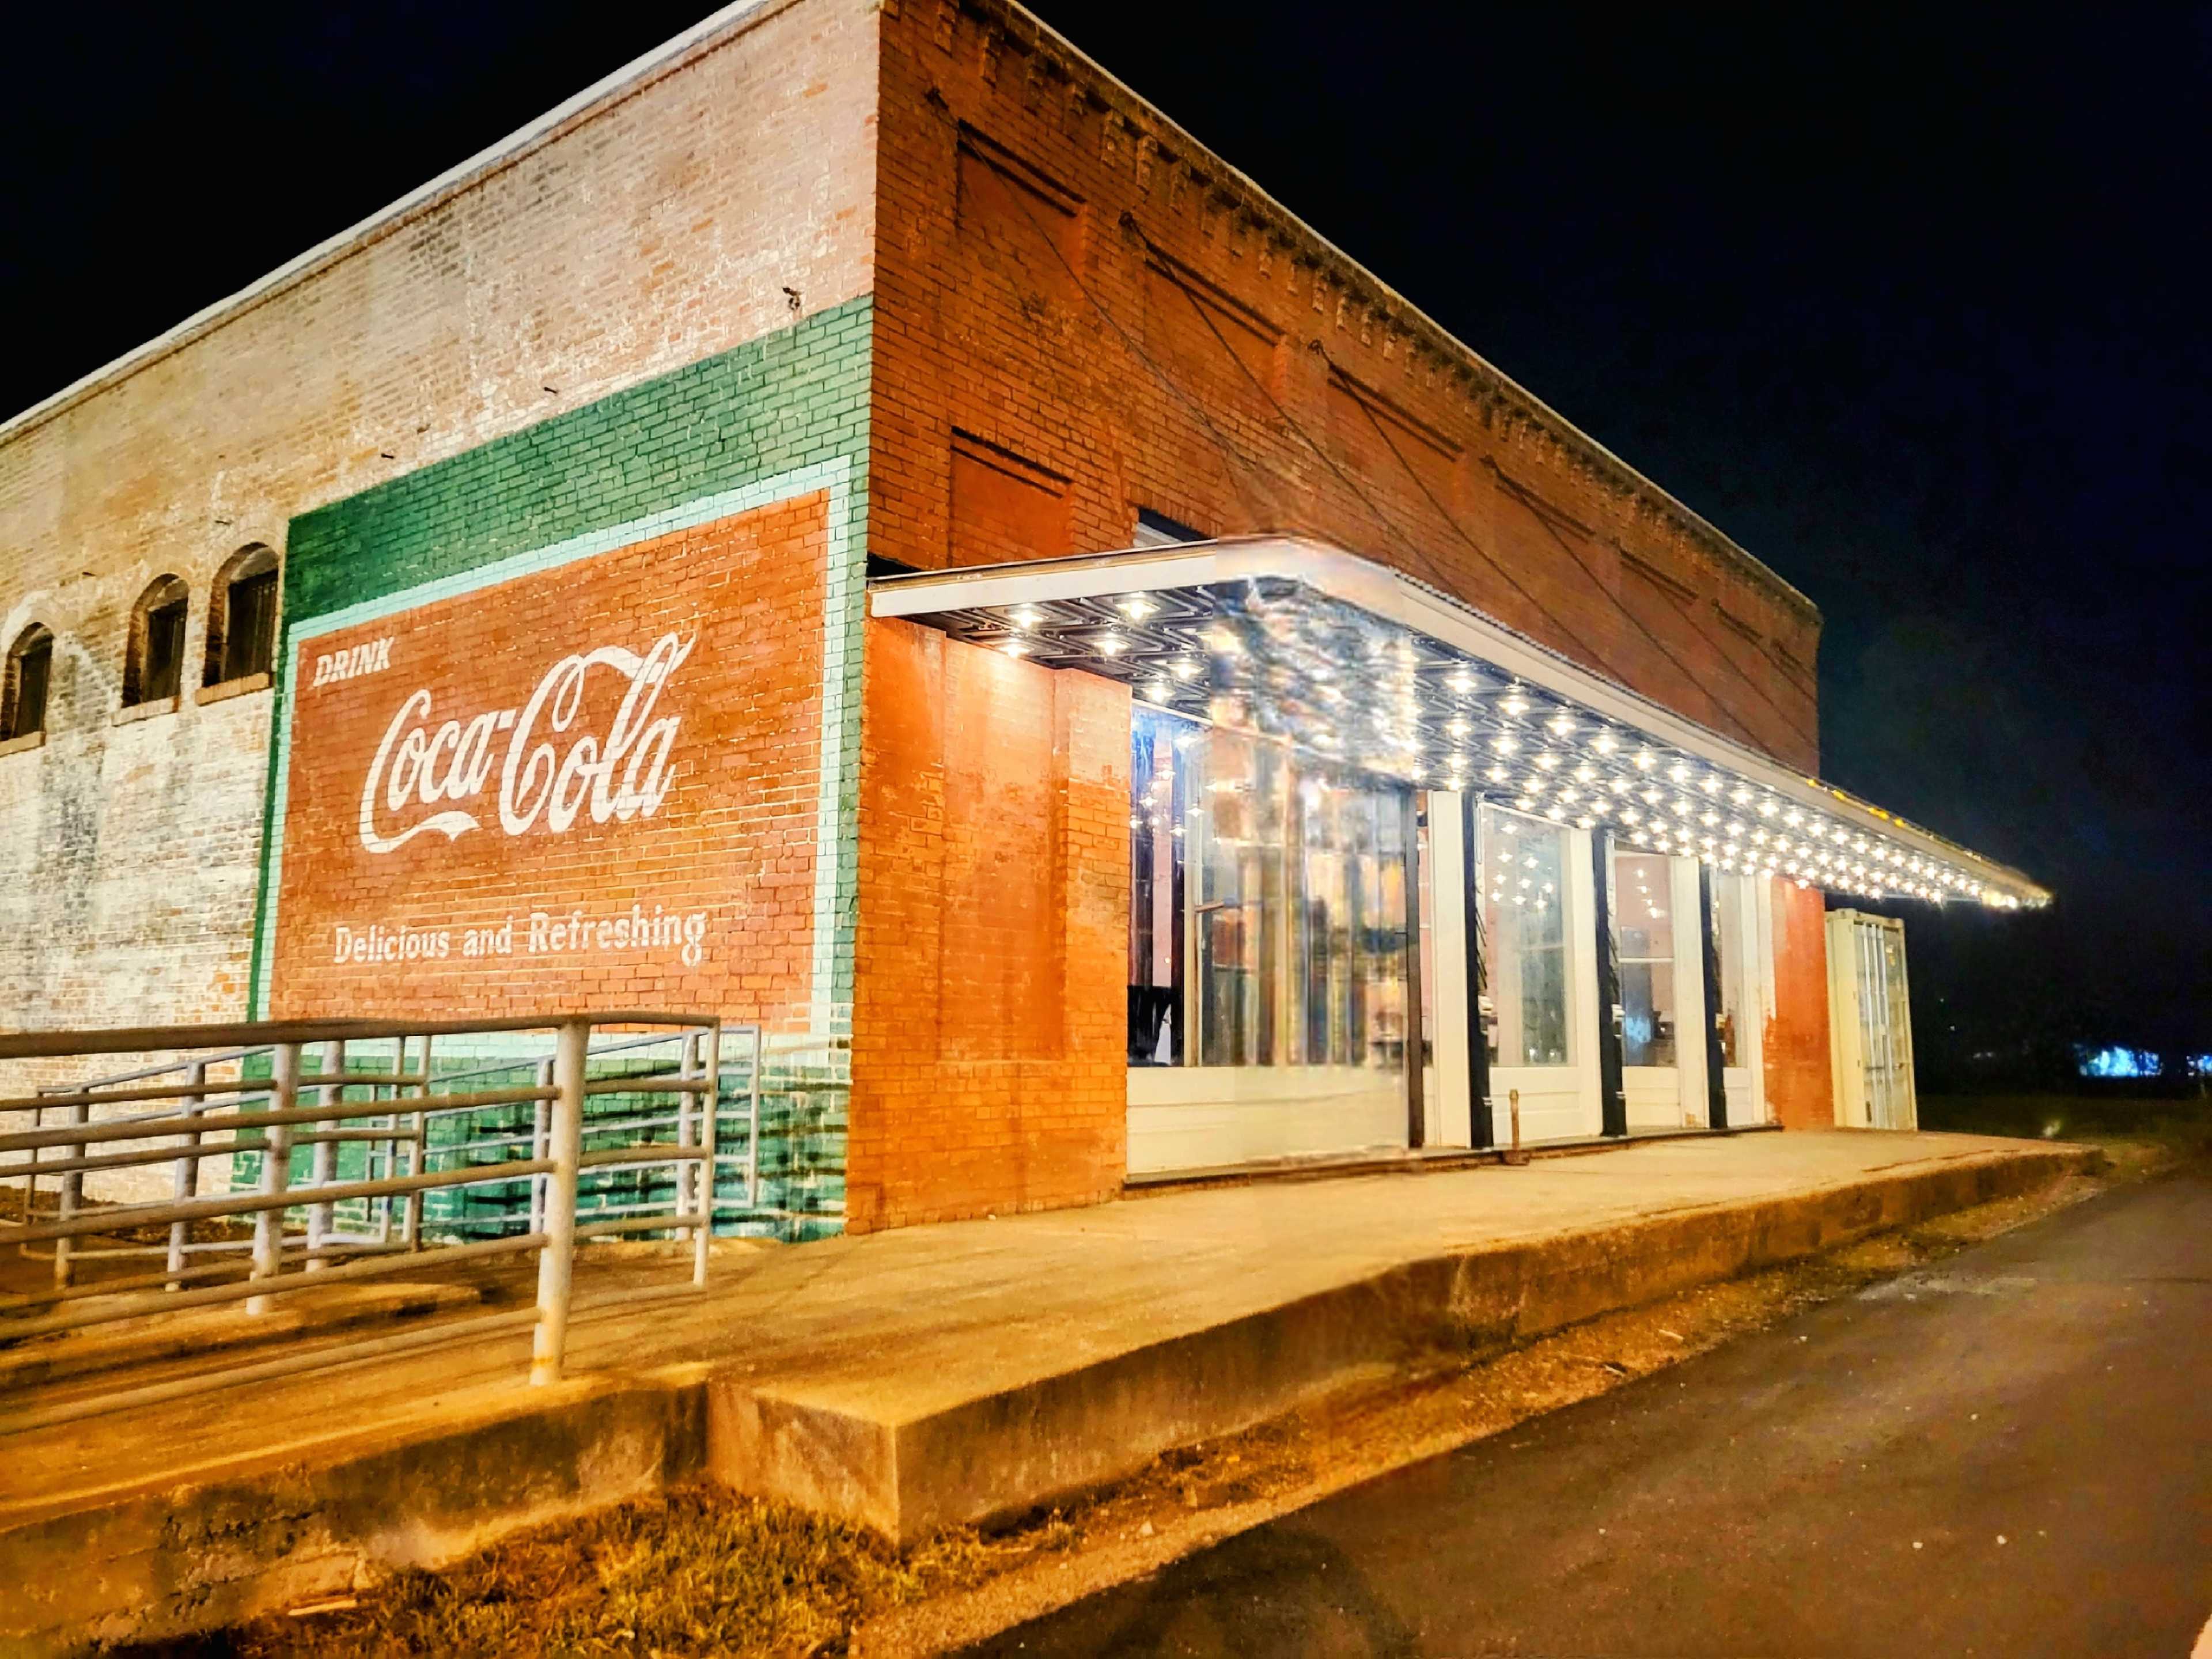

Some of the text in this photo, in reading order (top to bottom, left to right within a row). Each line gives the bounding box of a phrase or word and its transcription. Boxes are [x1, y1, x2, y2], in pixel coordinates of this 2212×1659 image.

[313, 637, 394, 687] DRINK
[359, 631, 696, 854] Coca-Cola
[334, 905, 707, 967] Delicious and Refreshing
